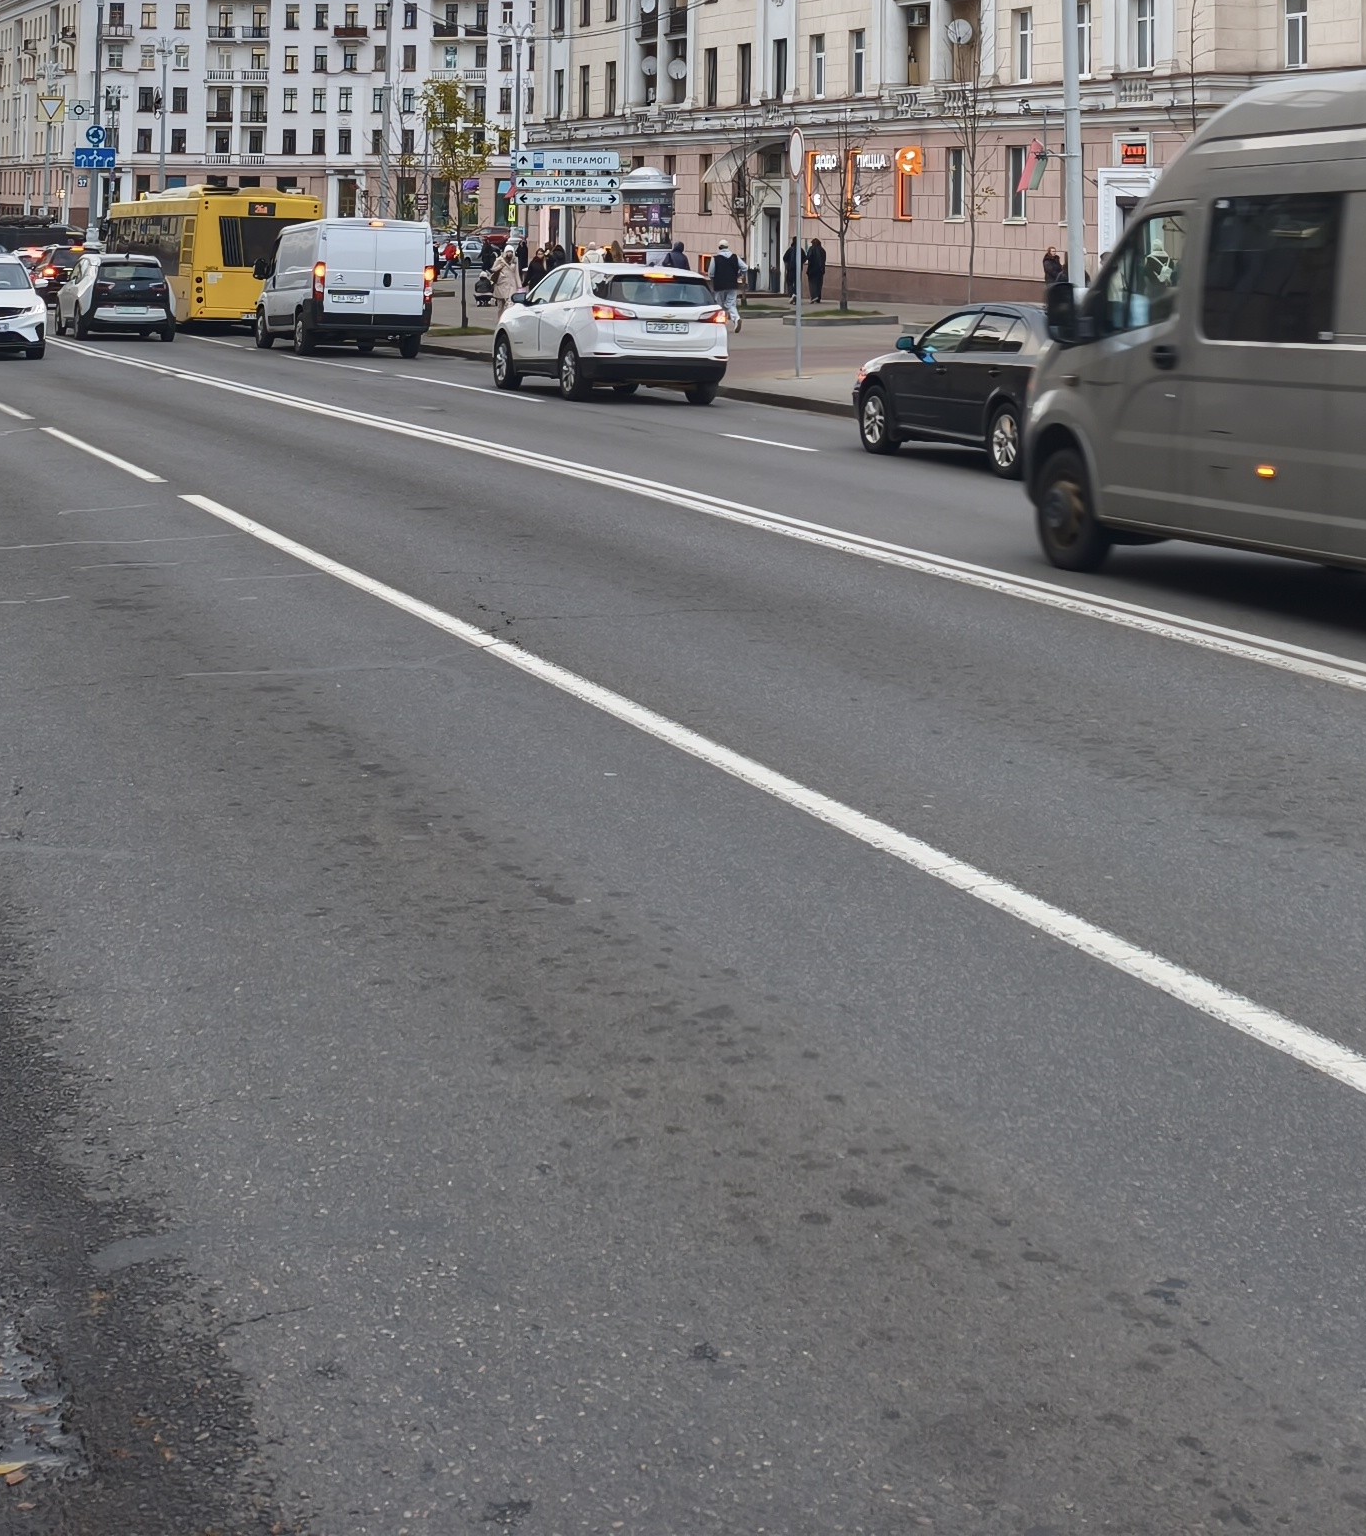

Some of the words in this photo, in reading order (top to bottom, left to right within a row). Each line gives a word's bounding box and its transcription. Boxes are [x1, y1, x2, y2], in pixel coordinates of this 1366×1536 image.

[566, 157, 611, 165] ПЕРАМОГІ
[814, 154, 837, 170] ДОДО
[856, 154, 887, 170] ПИЦЦА
[78, 179, 87, 187] 37
[535, 180, 552, 188] вул.
[553, 179, 599, 187] КІСЯЛЕВА
